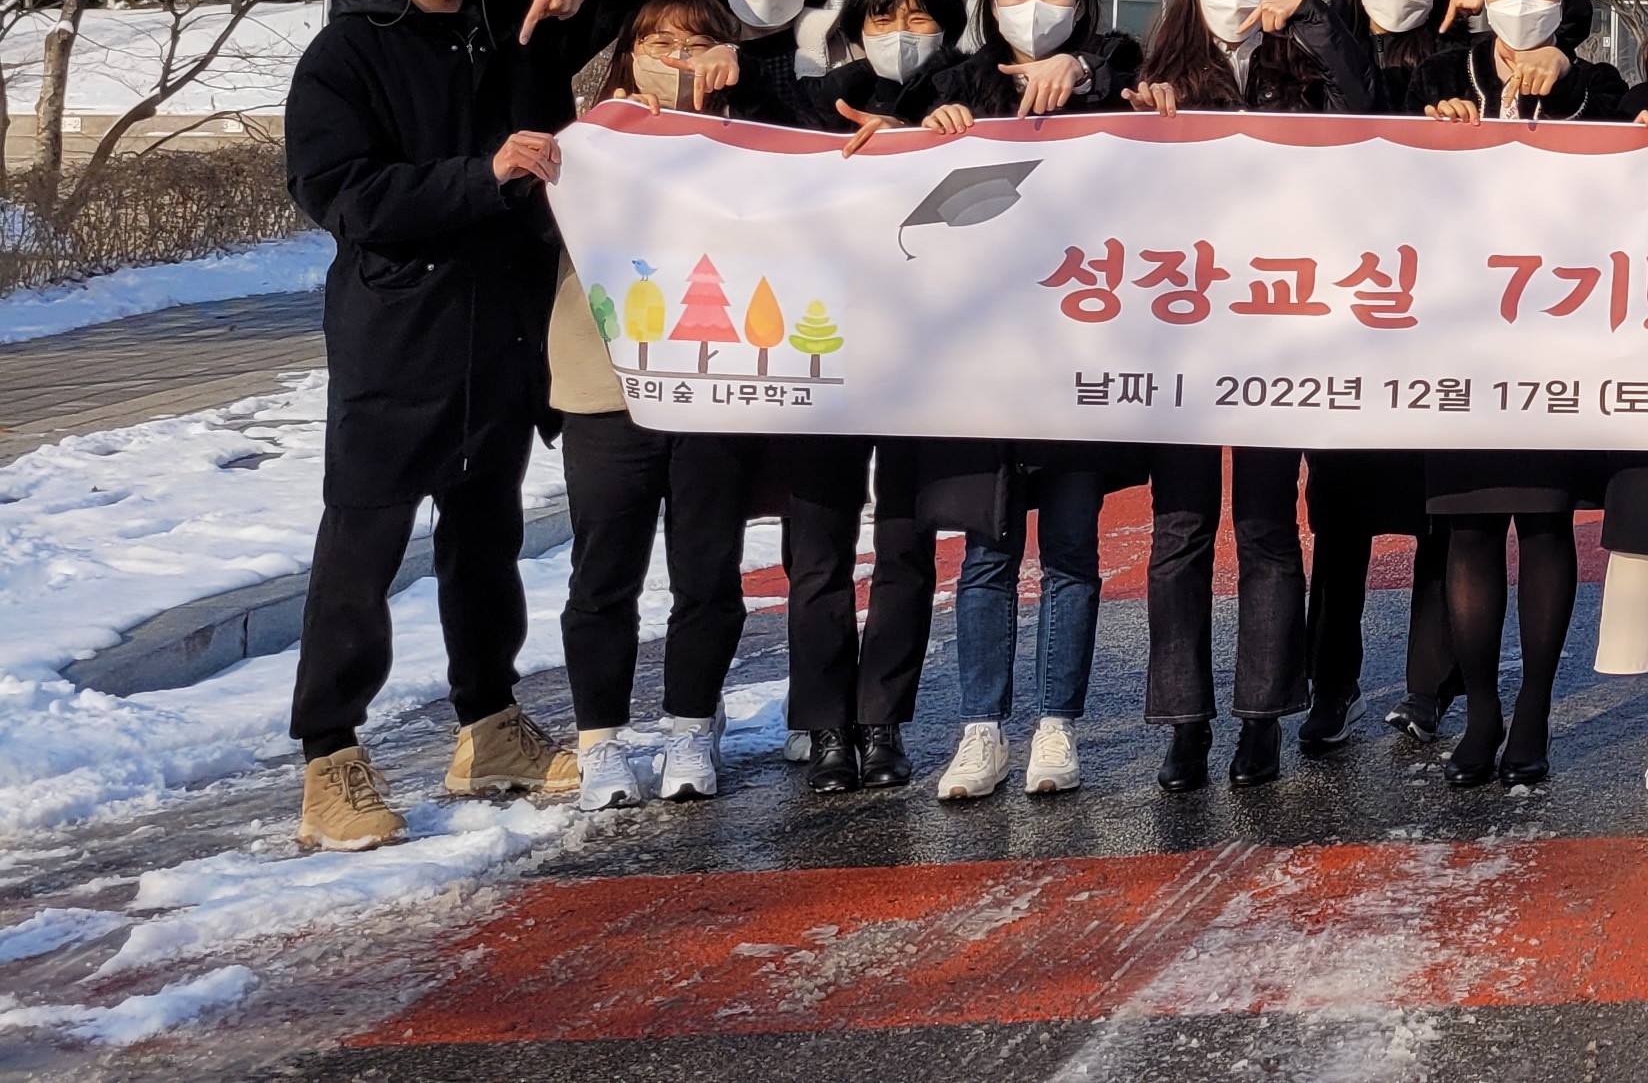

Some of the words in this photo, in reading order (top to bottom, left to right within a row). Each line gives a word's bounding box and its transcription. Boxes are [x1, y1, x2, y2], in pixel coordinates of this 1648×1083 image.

[1037, 238, 1418, 329] 성장교실
[618, 376, 663, 402] 움의
[672, 381, 694, 403] 숲
[712, 383, 813, 406] 나무학교
[1075, 371, 1159, 407] 날짜
[1215, 376, 1362, 410] 2022년
[1383, 378, 1472, 412] 12월
[1493, 380, 1580, 414] 17일
